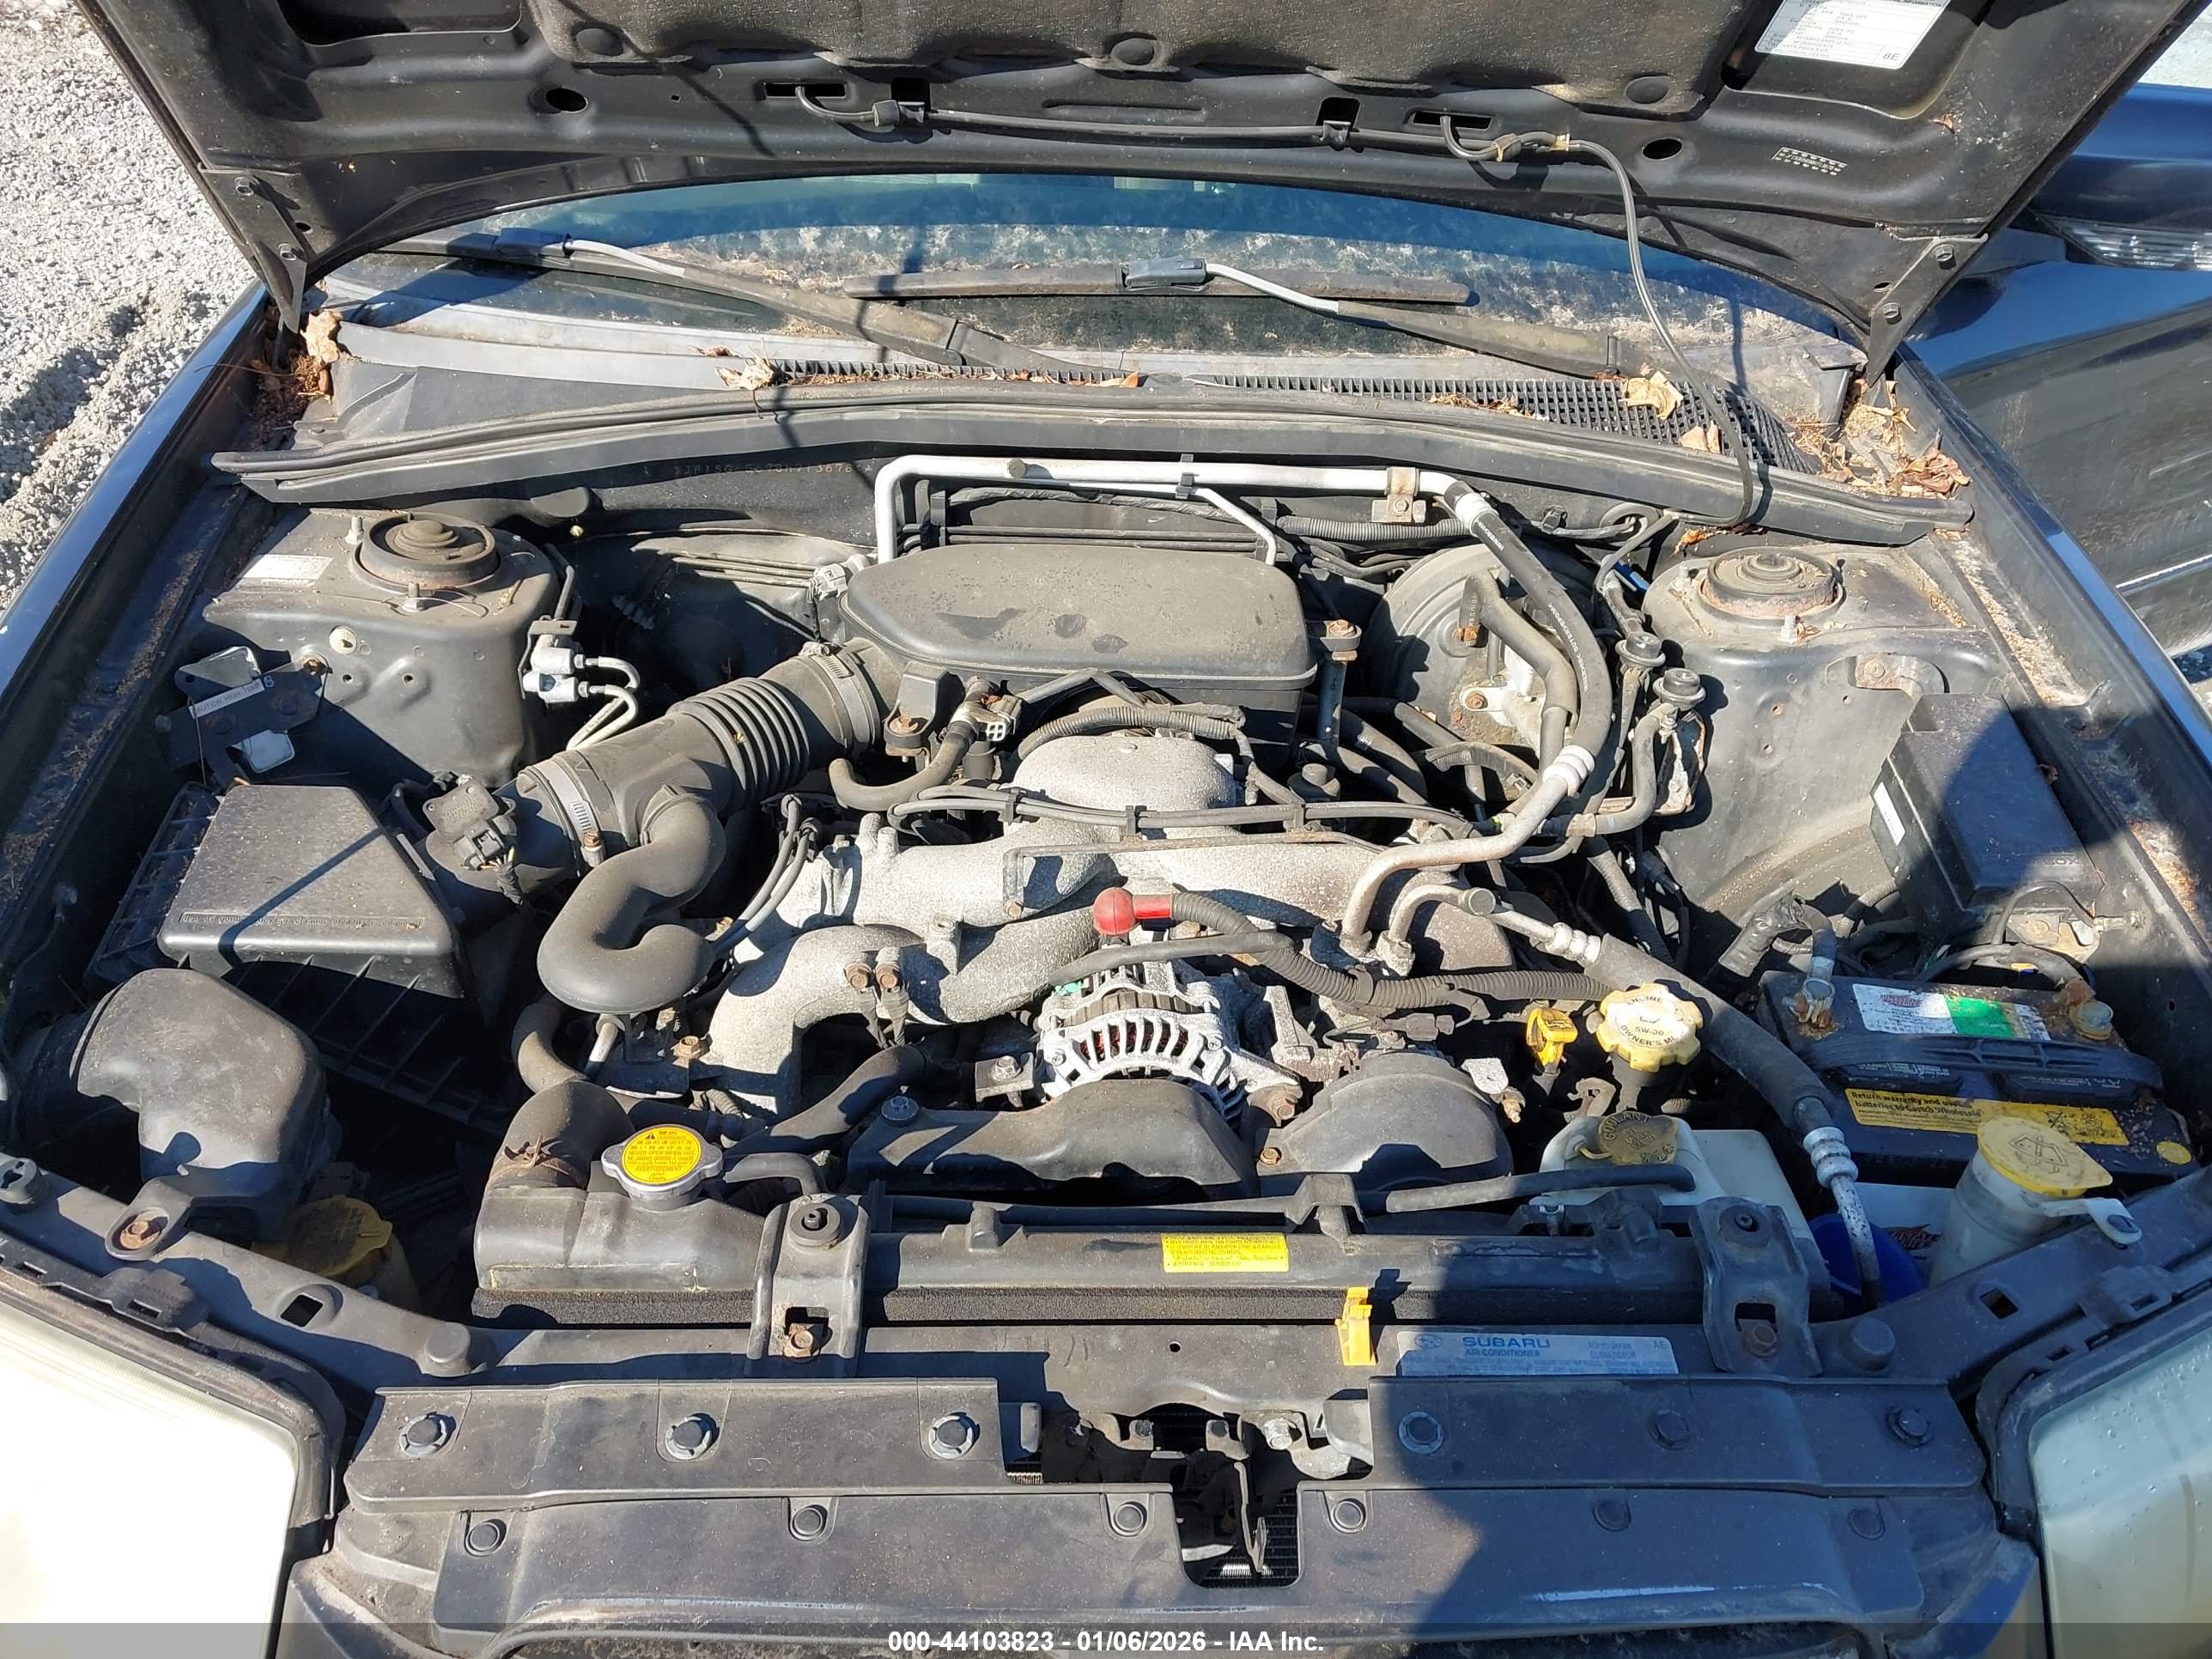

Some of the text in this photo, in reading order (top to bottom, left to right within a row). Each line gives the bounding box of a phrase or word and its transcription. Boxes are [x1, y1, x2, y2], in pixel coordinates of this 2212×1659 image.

[1882, 52, 1902, 62] 8E
[1850, 1091, 1881, 1101] Return
[1883, 1095, 1922, 1105] warranty
[1923, 1097, 1941, 1106] and
[1855, 1100, 1892, 1110] batteries
[1603, 1110, 1650, 1140] COOLANT
[1462, 1336, 1551, 1348] SUBARU
[1481, 1348, 1540, 1358] CONDITIONER
